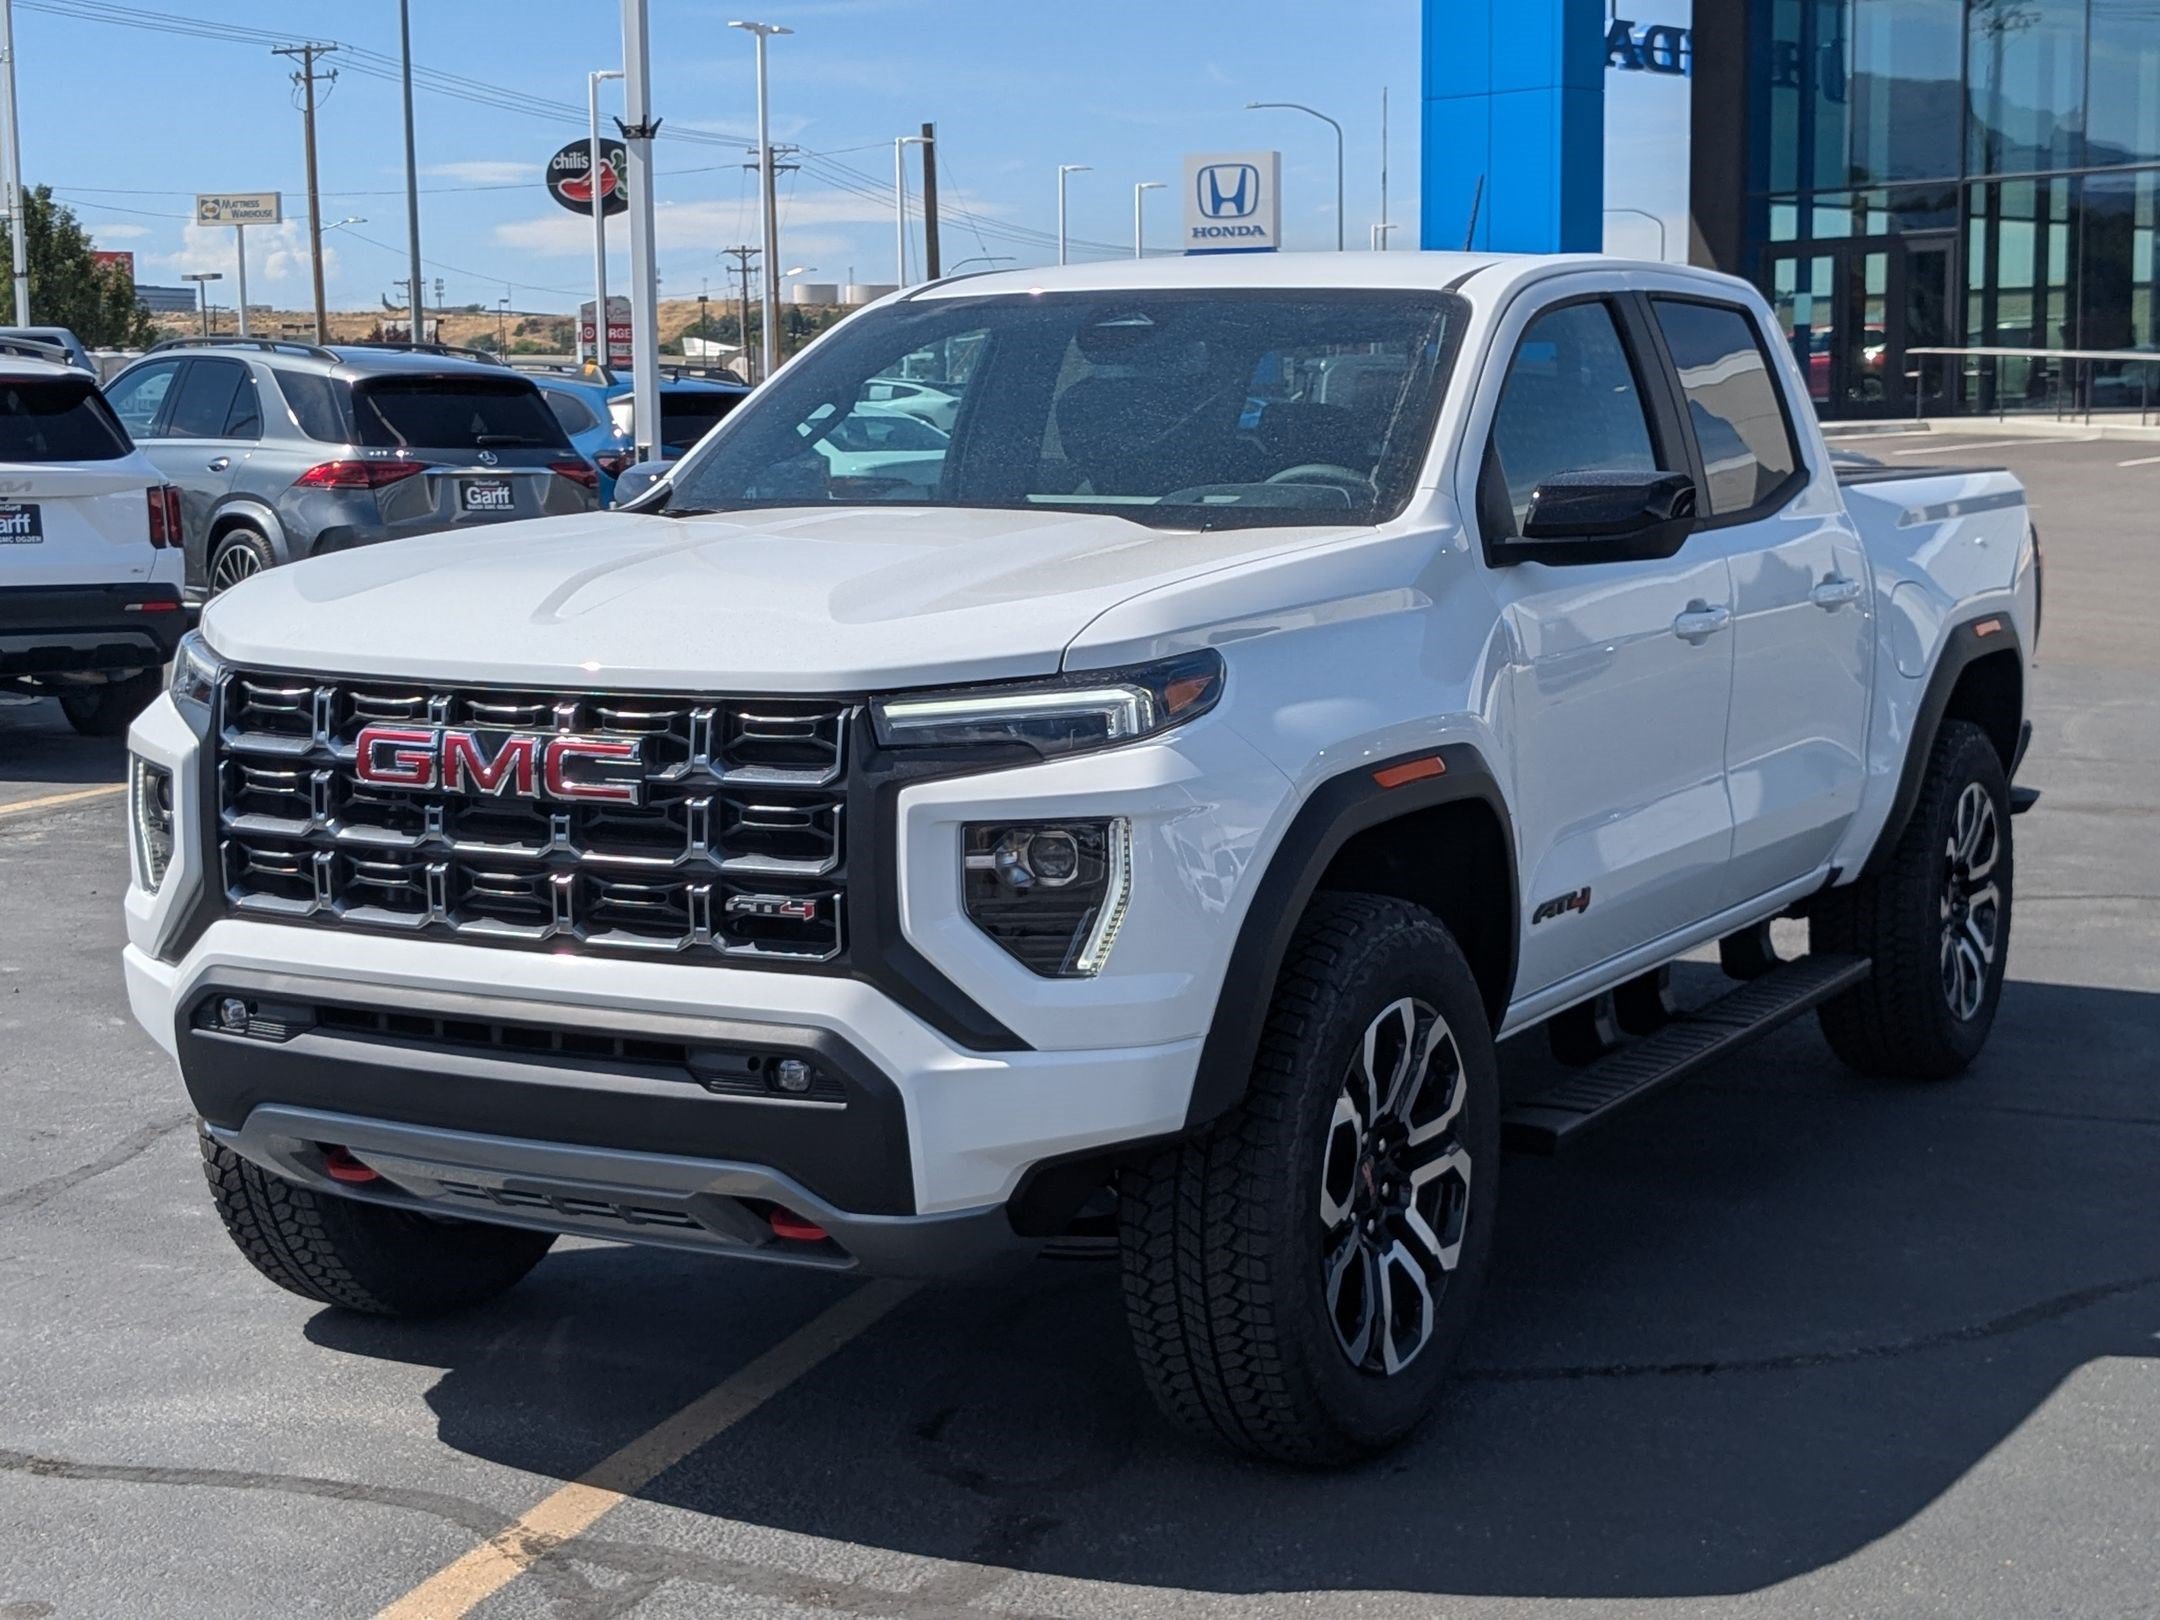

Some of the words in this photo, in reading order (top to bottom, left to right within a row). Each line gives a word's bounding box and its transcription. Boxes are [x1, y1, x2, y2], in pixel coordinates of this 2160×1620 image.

[552, 151, 590, 170] chili's
[221, 199, 260, 209] MATTRESS
[231, 209, 273, 219] WAREHOUSE
[1192, 225, 1266, 238] HONDA
[466, 486, 510, 504] Garff
[0, 513, 31, 534] arff
[355, 726, 641, 806] GMC
[725, 894, 817, 921] AT4
[1532, 886, 1592, 925] AT4
